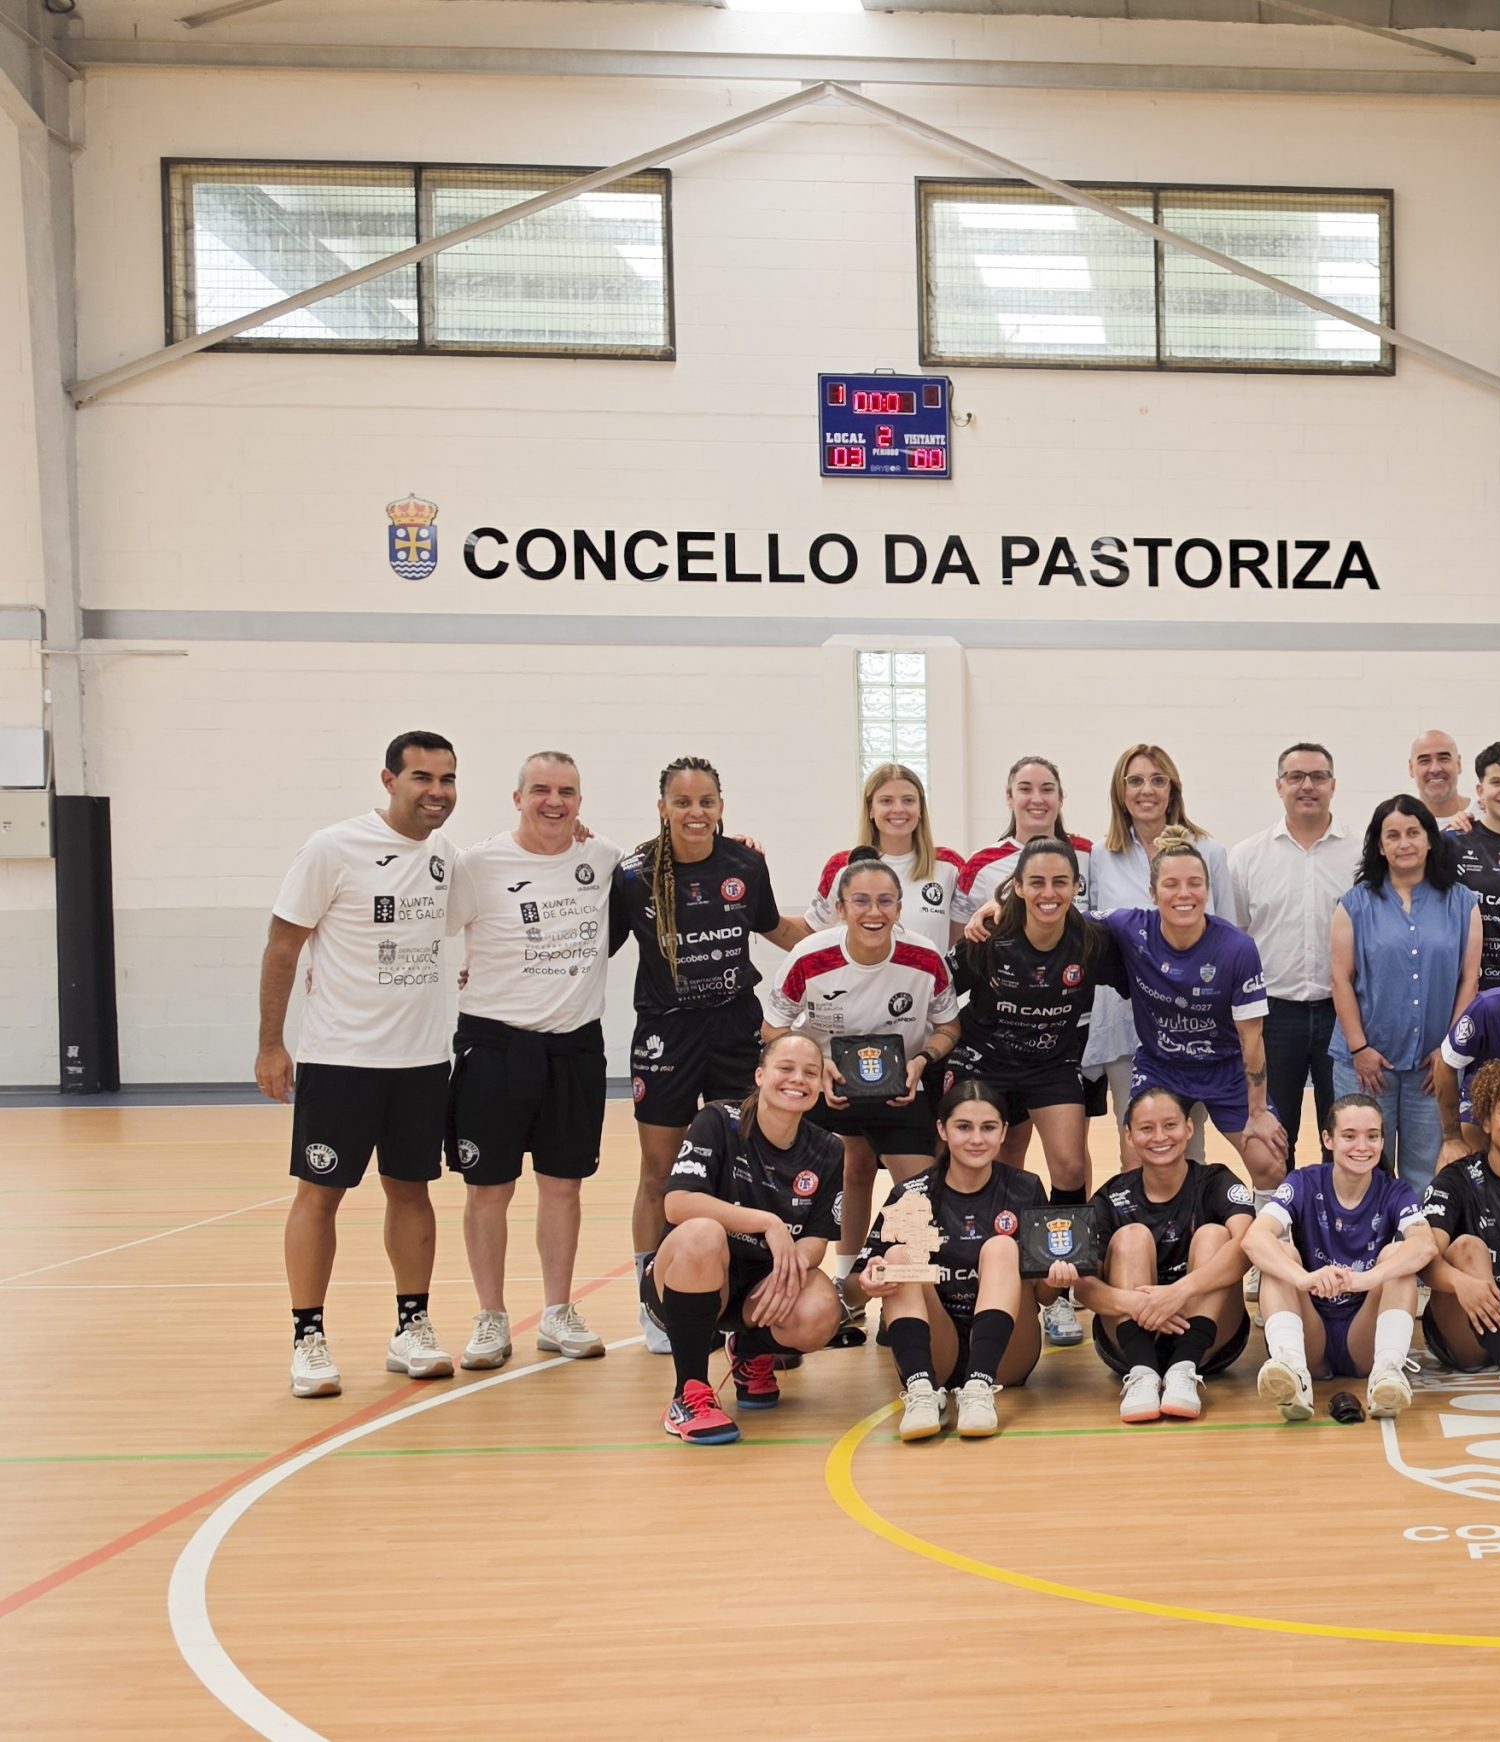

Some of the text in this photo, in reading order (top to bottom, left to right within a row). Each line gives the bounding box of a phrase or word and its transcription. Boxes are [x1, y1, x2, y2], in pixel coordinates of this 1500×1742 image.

[825, 432, 866, 444] LOCAL
[878, 426, 892, 447] 2
[904, 434, 946, 445] VISITANTE
[834, 447, 862, 467] 03
[914, 448, 942, 468] 00
[463, 526, 1380, 590] CONCELLO DA PASTORIZA
[400, 896, 435, 908] XUNTA
[542, 898, 577, 909] XUNTA
[398, 910, 412, 920] DE
[543, 906, 600, 920] DE GALICIA
[686, 926, 743, 944] CANDO
[524, 946, 598, 962] Deportes
[675, 948, 742, 965] acobeo 2027
[1020, 1004, 1072, 1016] CANDO
[1190, 1003, 1212, 1012] 2027
